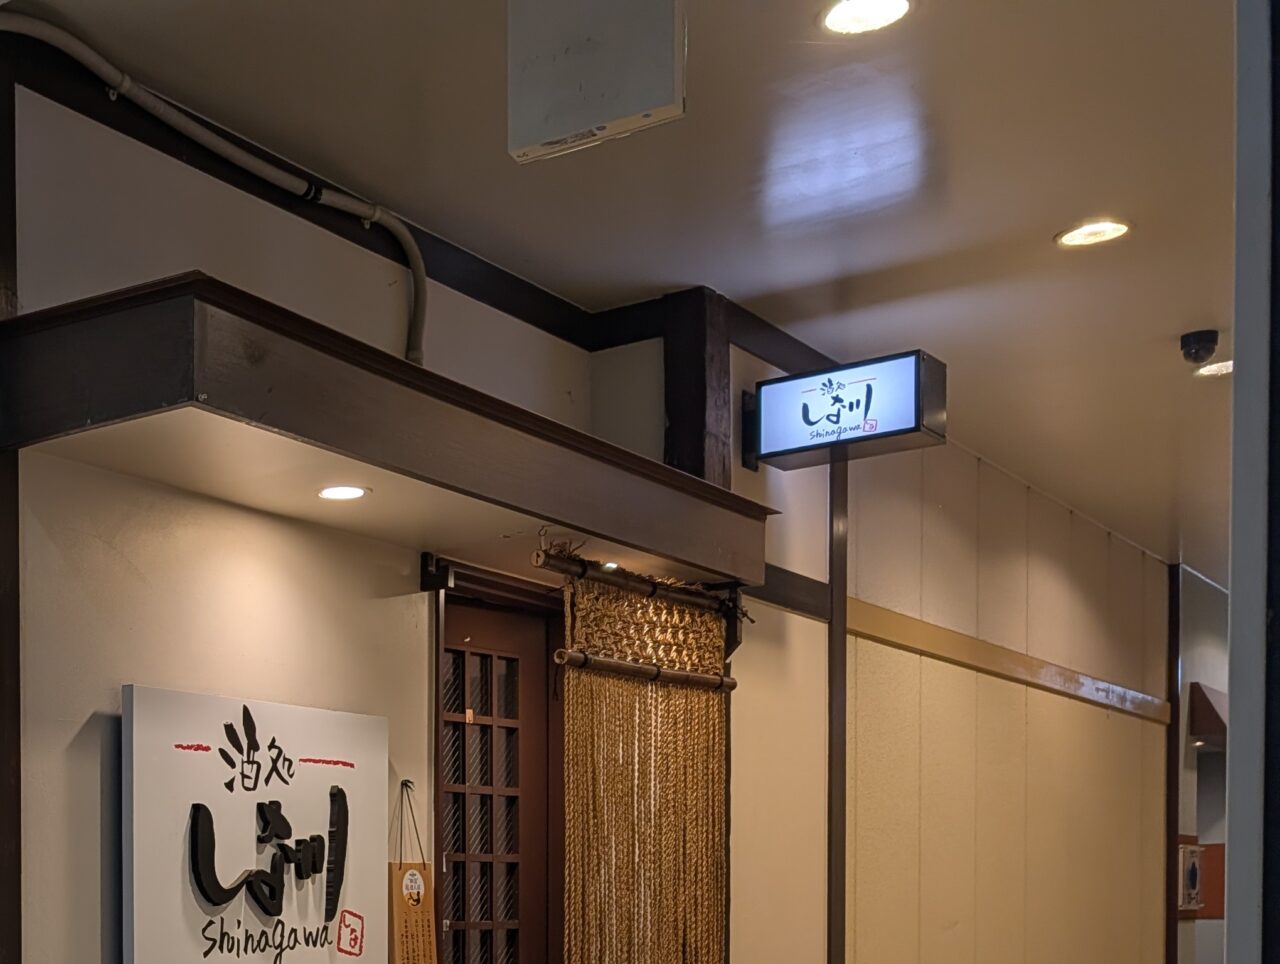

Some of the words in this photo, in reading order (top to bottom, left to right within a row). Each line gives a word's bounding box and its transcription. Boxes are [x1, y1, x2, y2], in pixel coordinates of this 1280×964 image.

[801, 383, 873, 427] しな川
[819, 377, 846, 396] 酒処
[217, 703, 297, 794] 酒処
[190, 784, 350, 923] しな川
